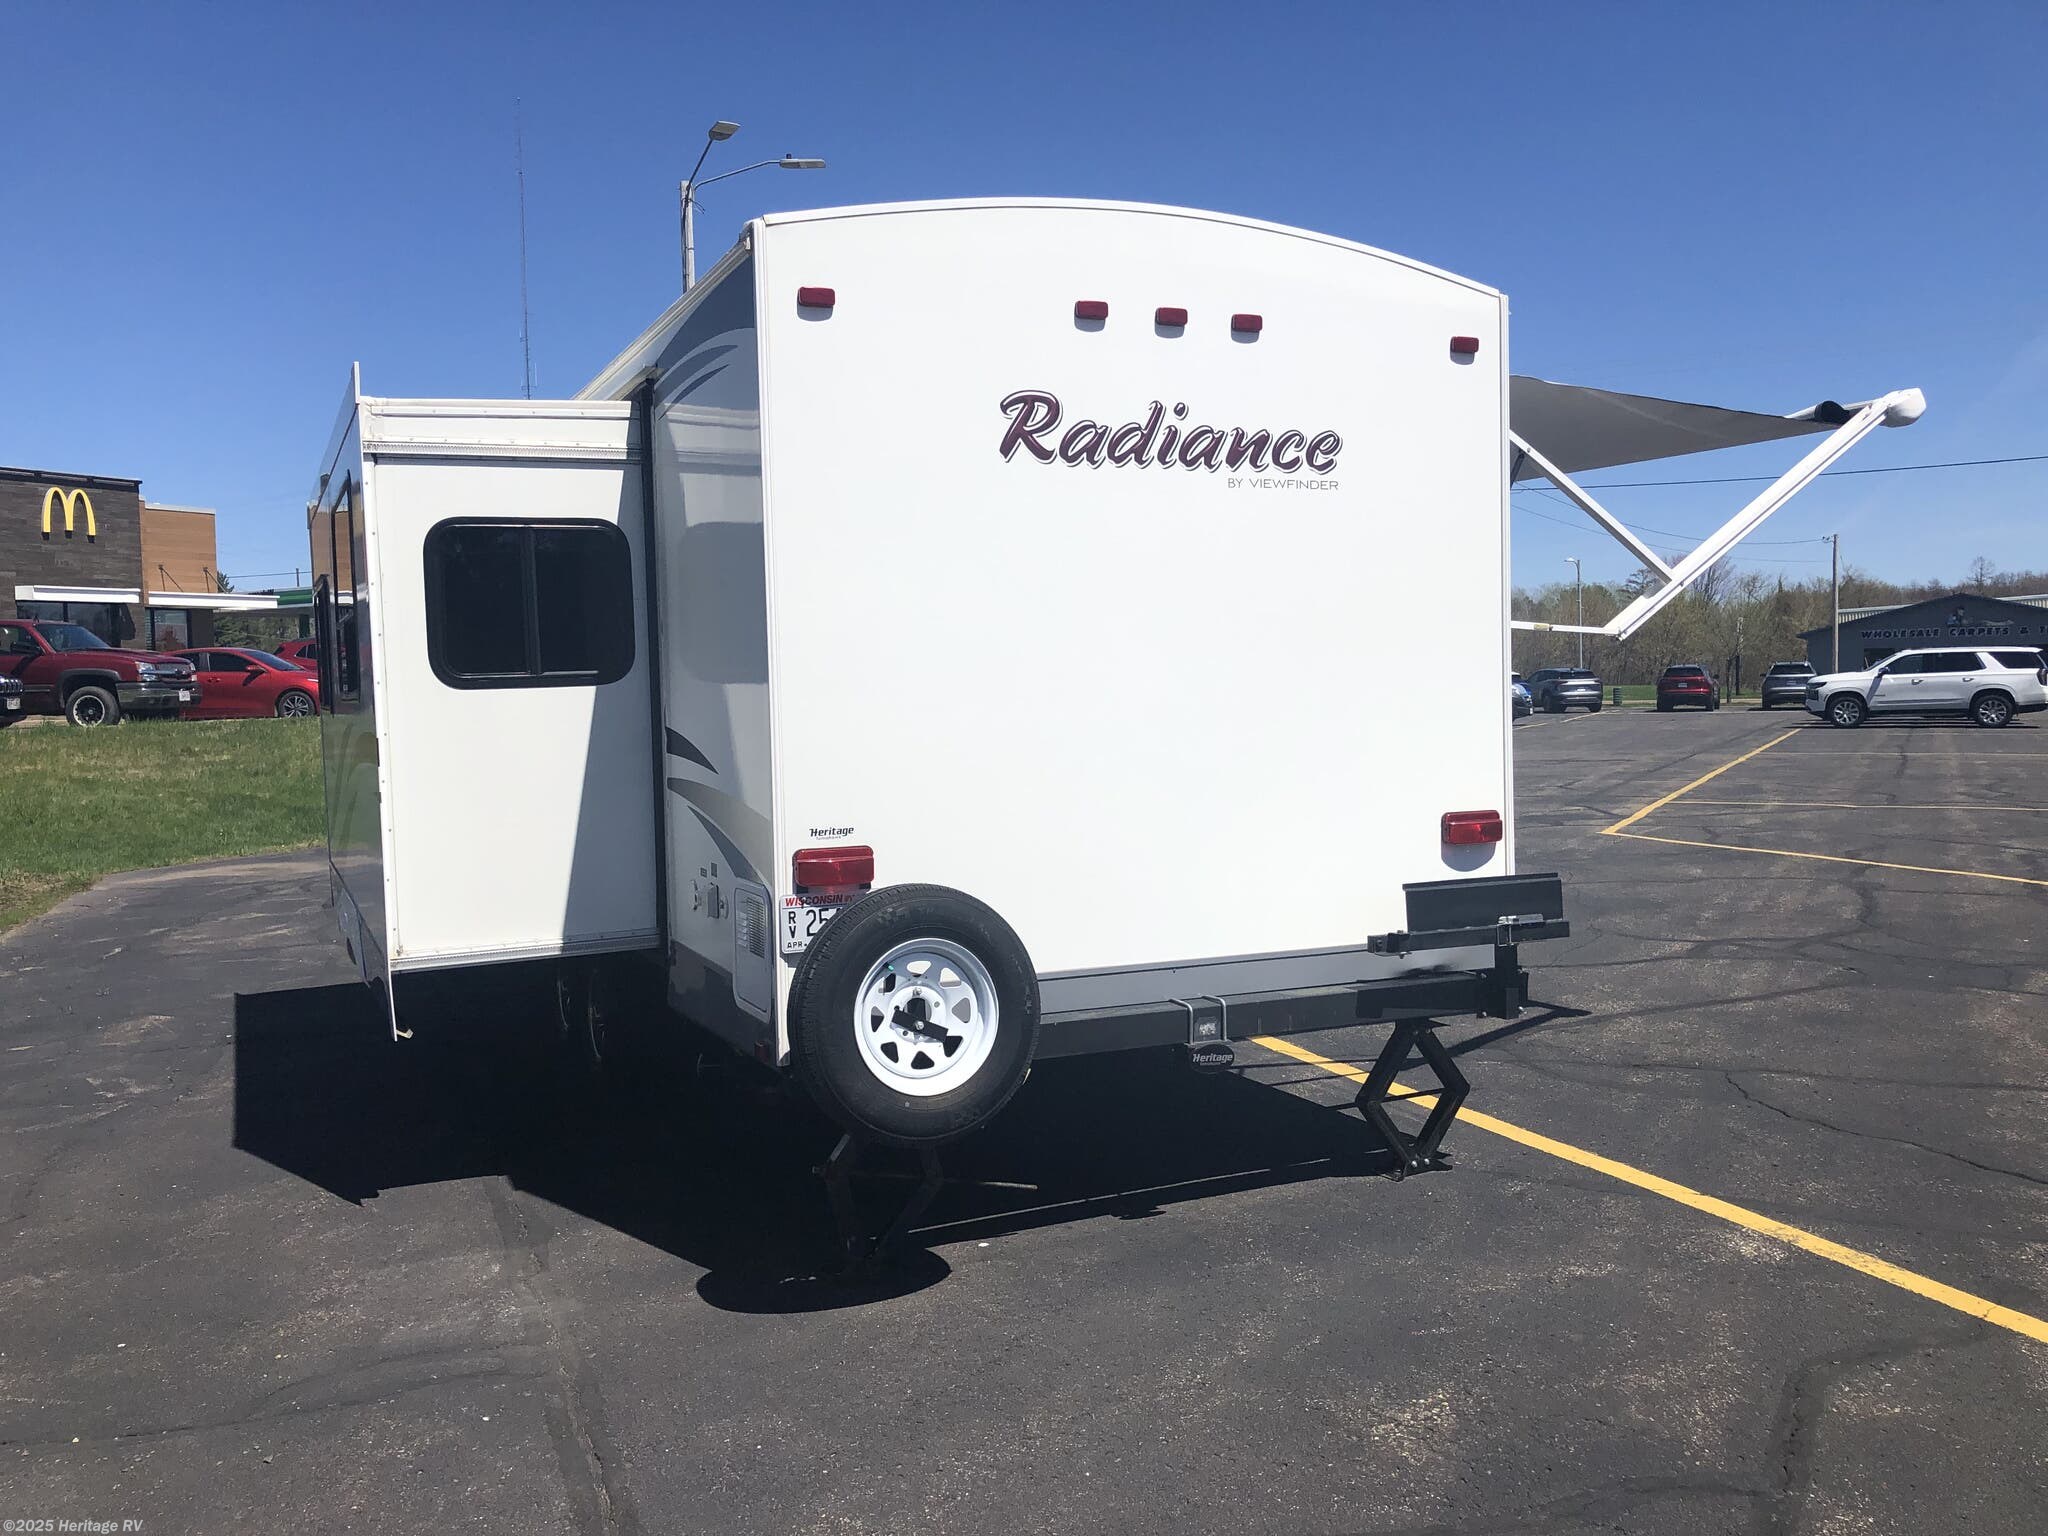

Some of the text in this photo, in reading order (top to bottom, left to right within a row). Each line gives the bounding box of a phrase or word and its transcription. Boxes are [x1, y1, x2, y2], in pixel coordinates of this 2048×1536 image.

[999, 389, 1343, 475] Radiance
[1227, 478, 1339, 490] BY VIEWFINDER
[1861, 628, 1940, 639] WHOLESALE
[1949, 626, 2010, 637] CARPETS
[2019, 626, 2029, 635] &
[809, 826, 855, 837] Heritage
[785, 894, 843, 907] WISCONSIN
[1192, 1053, 1233, 1064] Heritage
